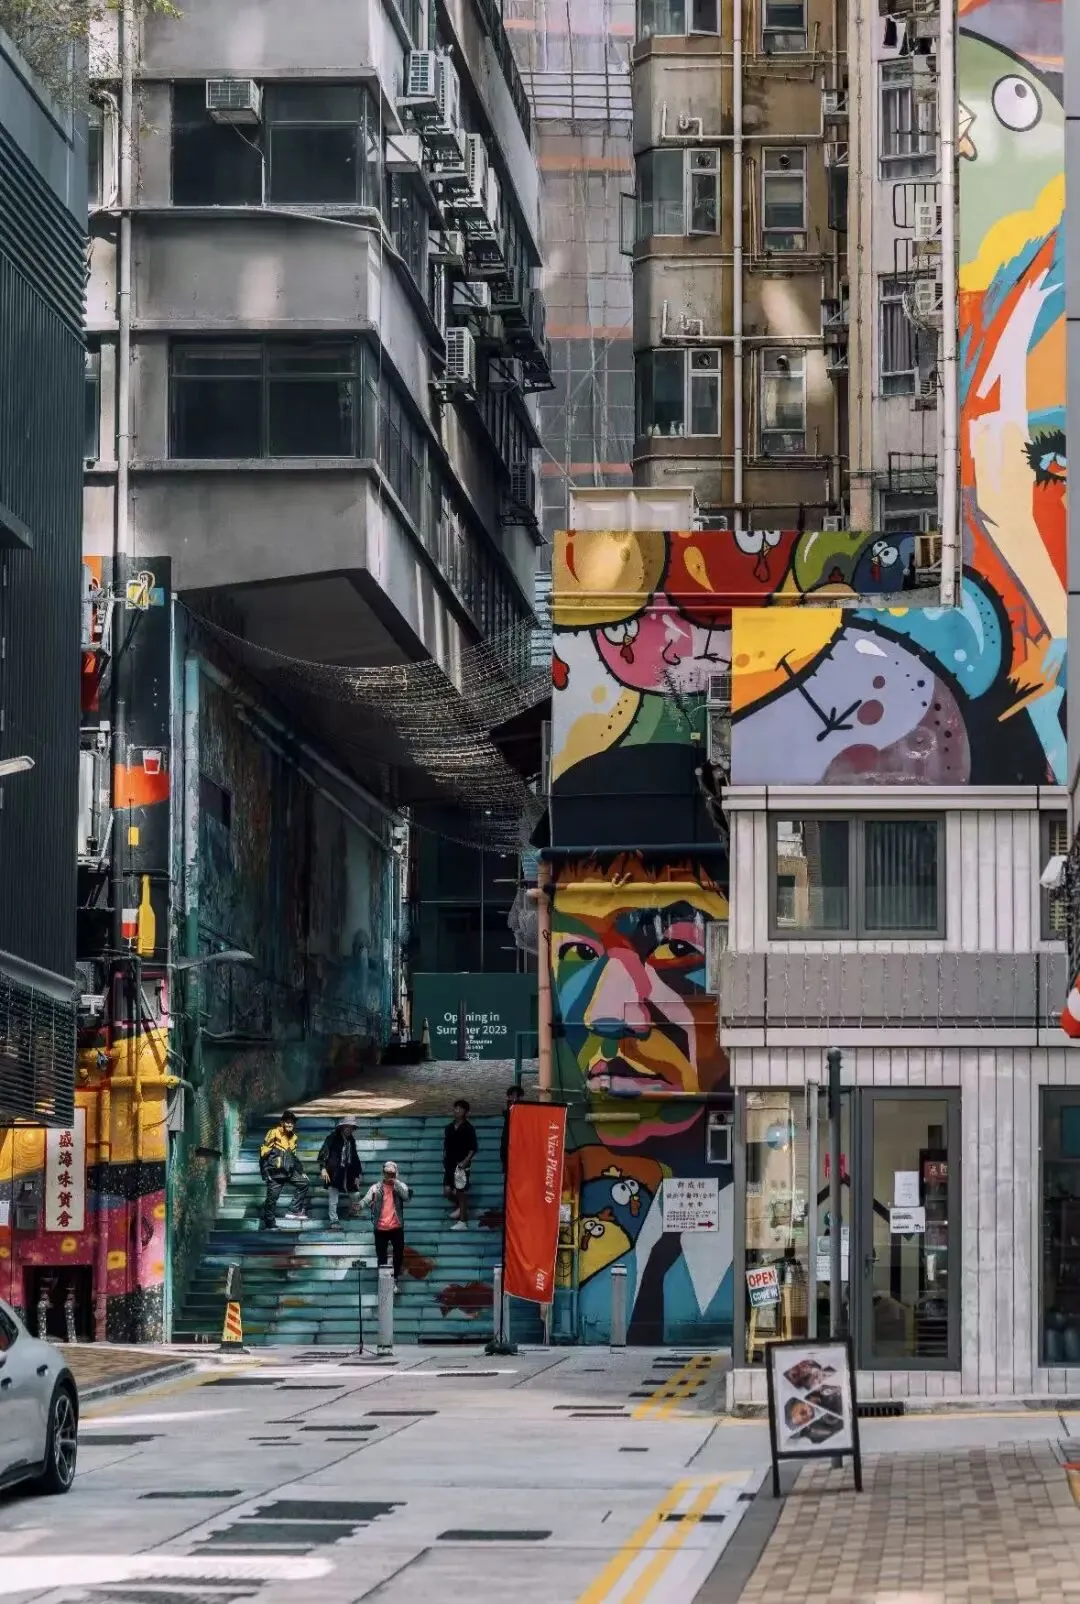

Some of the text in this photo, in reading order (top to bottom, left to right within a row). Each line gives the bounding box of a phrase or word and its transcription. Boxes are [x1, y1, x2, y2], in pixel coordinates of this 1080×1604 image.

[444, 1012, 500, 1023] Opning in
[482, 1025, 507, 1035] 2023
[547, 1134, 559, 1157] Nice
[545, 1157, 558, 1188] Place
[748, 1270, 776, 1287] OPEN
[752, 1287, 778, 1301] COME IN
